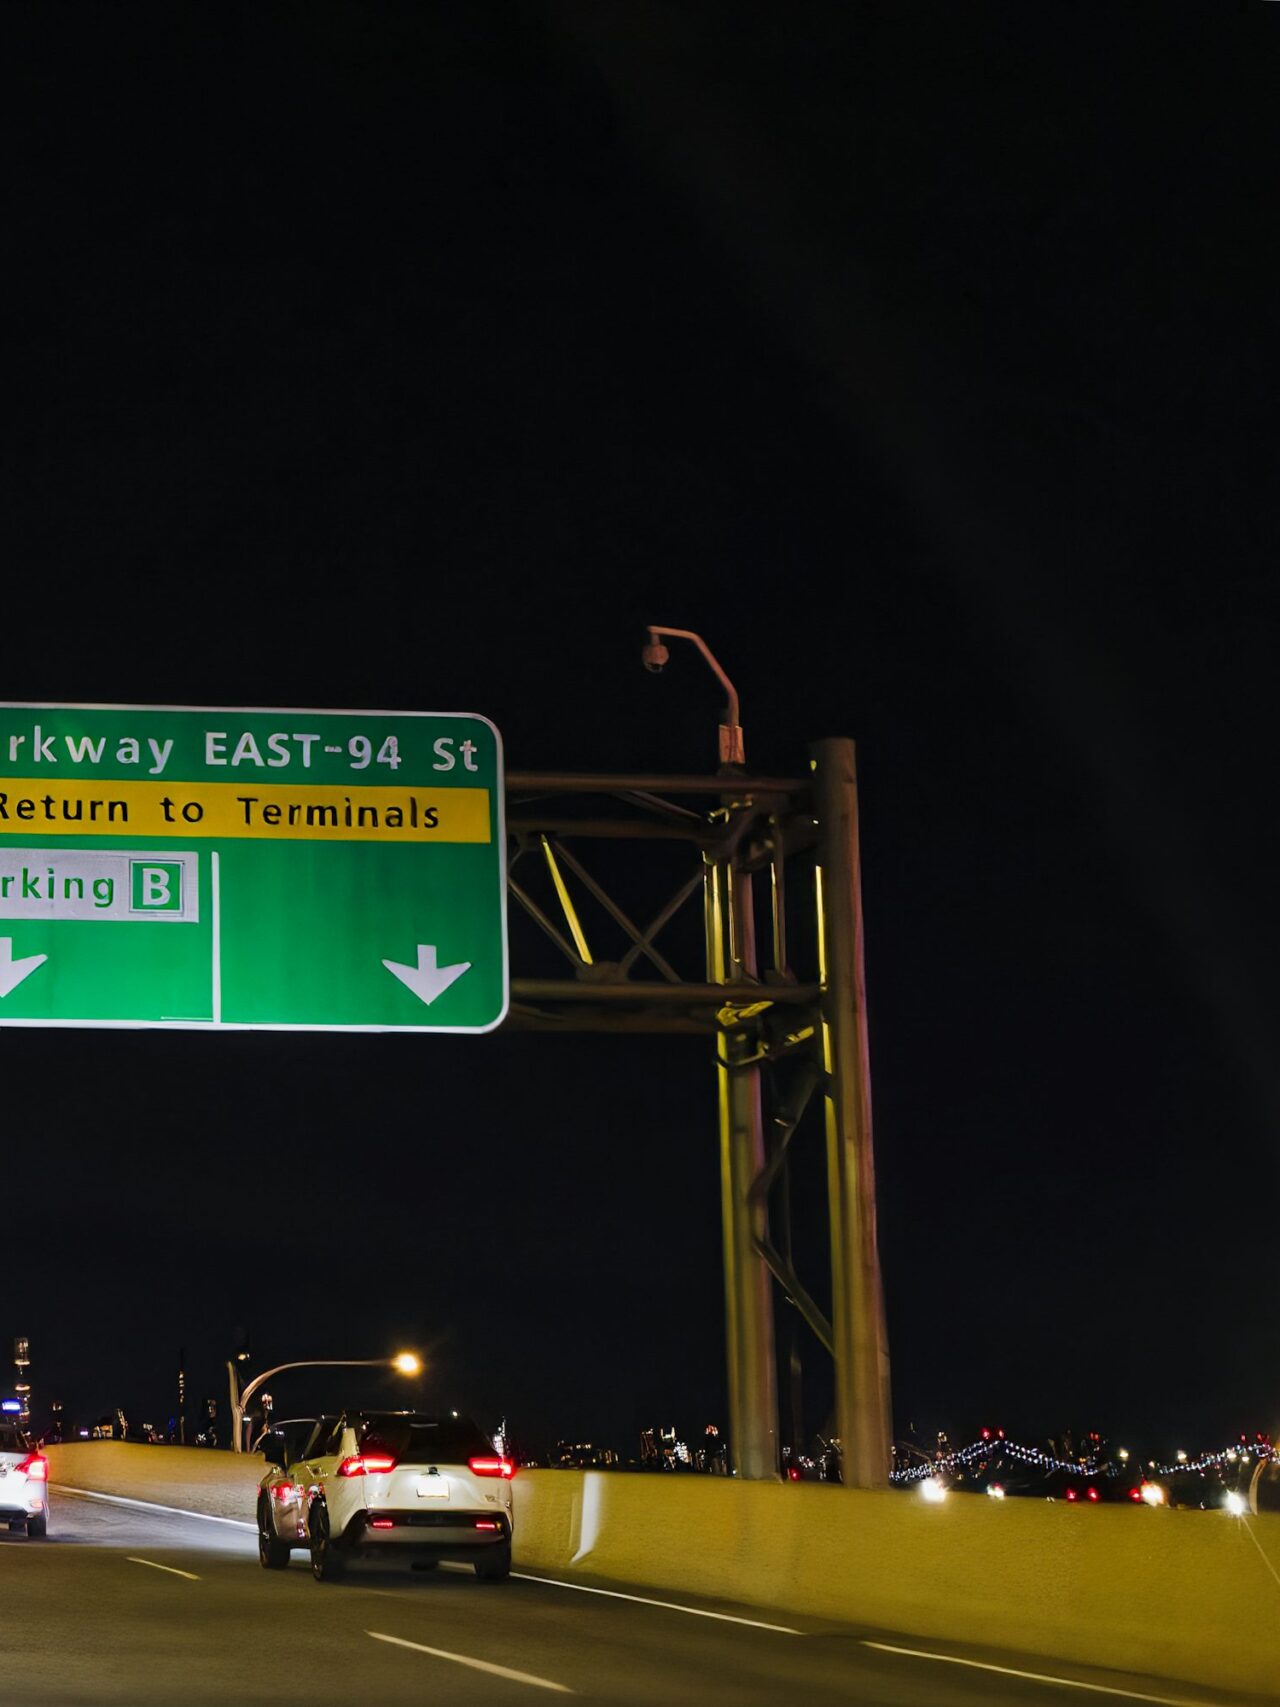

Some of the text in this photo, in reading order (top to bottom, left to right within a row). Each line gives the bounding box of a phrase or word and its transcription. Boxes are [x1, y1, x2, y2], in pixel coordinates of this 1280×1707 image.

[205, 731, 402, 770] EAST-94
[432, 737, 479, 771] St
[160, 797, 204, 823] to
[237, 797, 439, 828] Terminals
[141, 868, 171, 906] B
